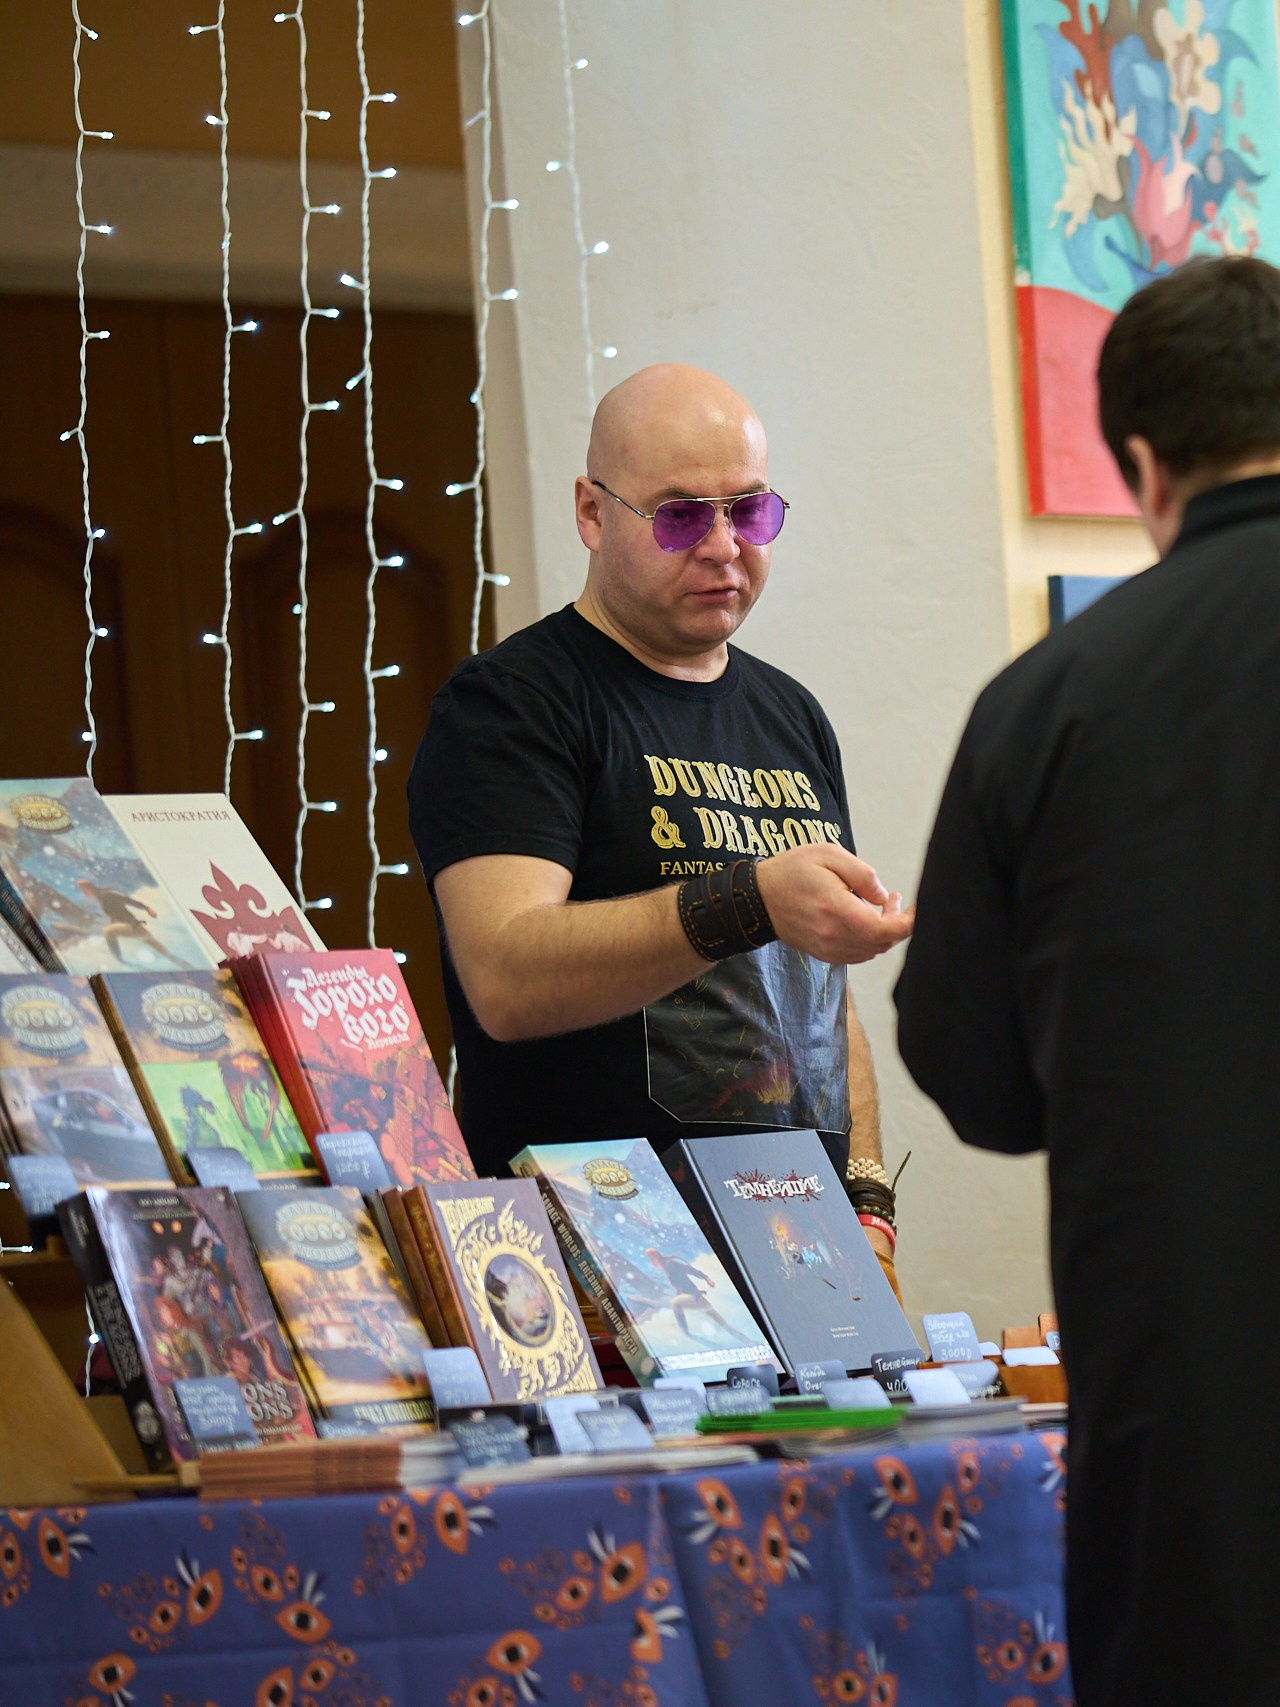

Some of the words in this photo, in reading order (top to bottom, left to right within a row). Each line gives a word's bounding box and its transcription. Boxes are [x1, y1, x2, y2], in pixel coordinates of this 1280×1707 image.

[643, 754, 821, 811] DUNGEONS
[131, 810, 231, 822] АРИСТОКРАТИЯ
[650, 805, 686, 849] &
[660, 861, 727, 875] FANTAS
